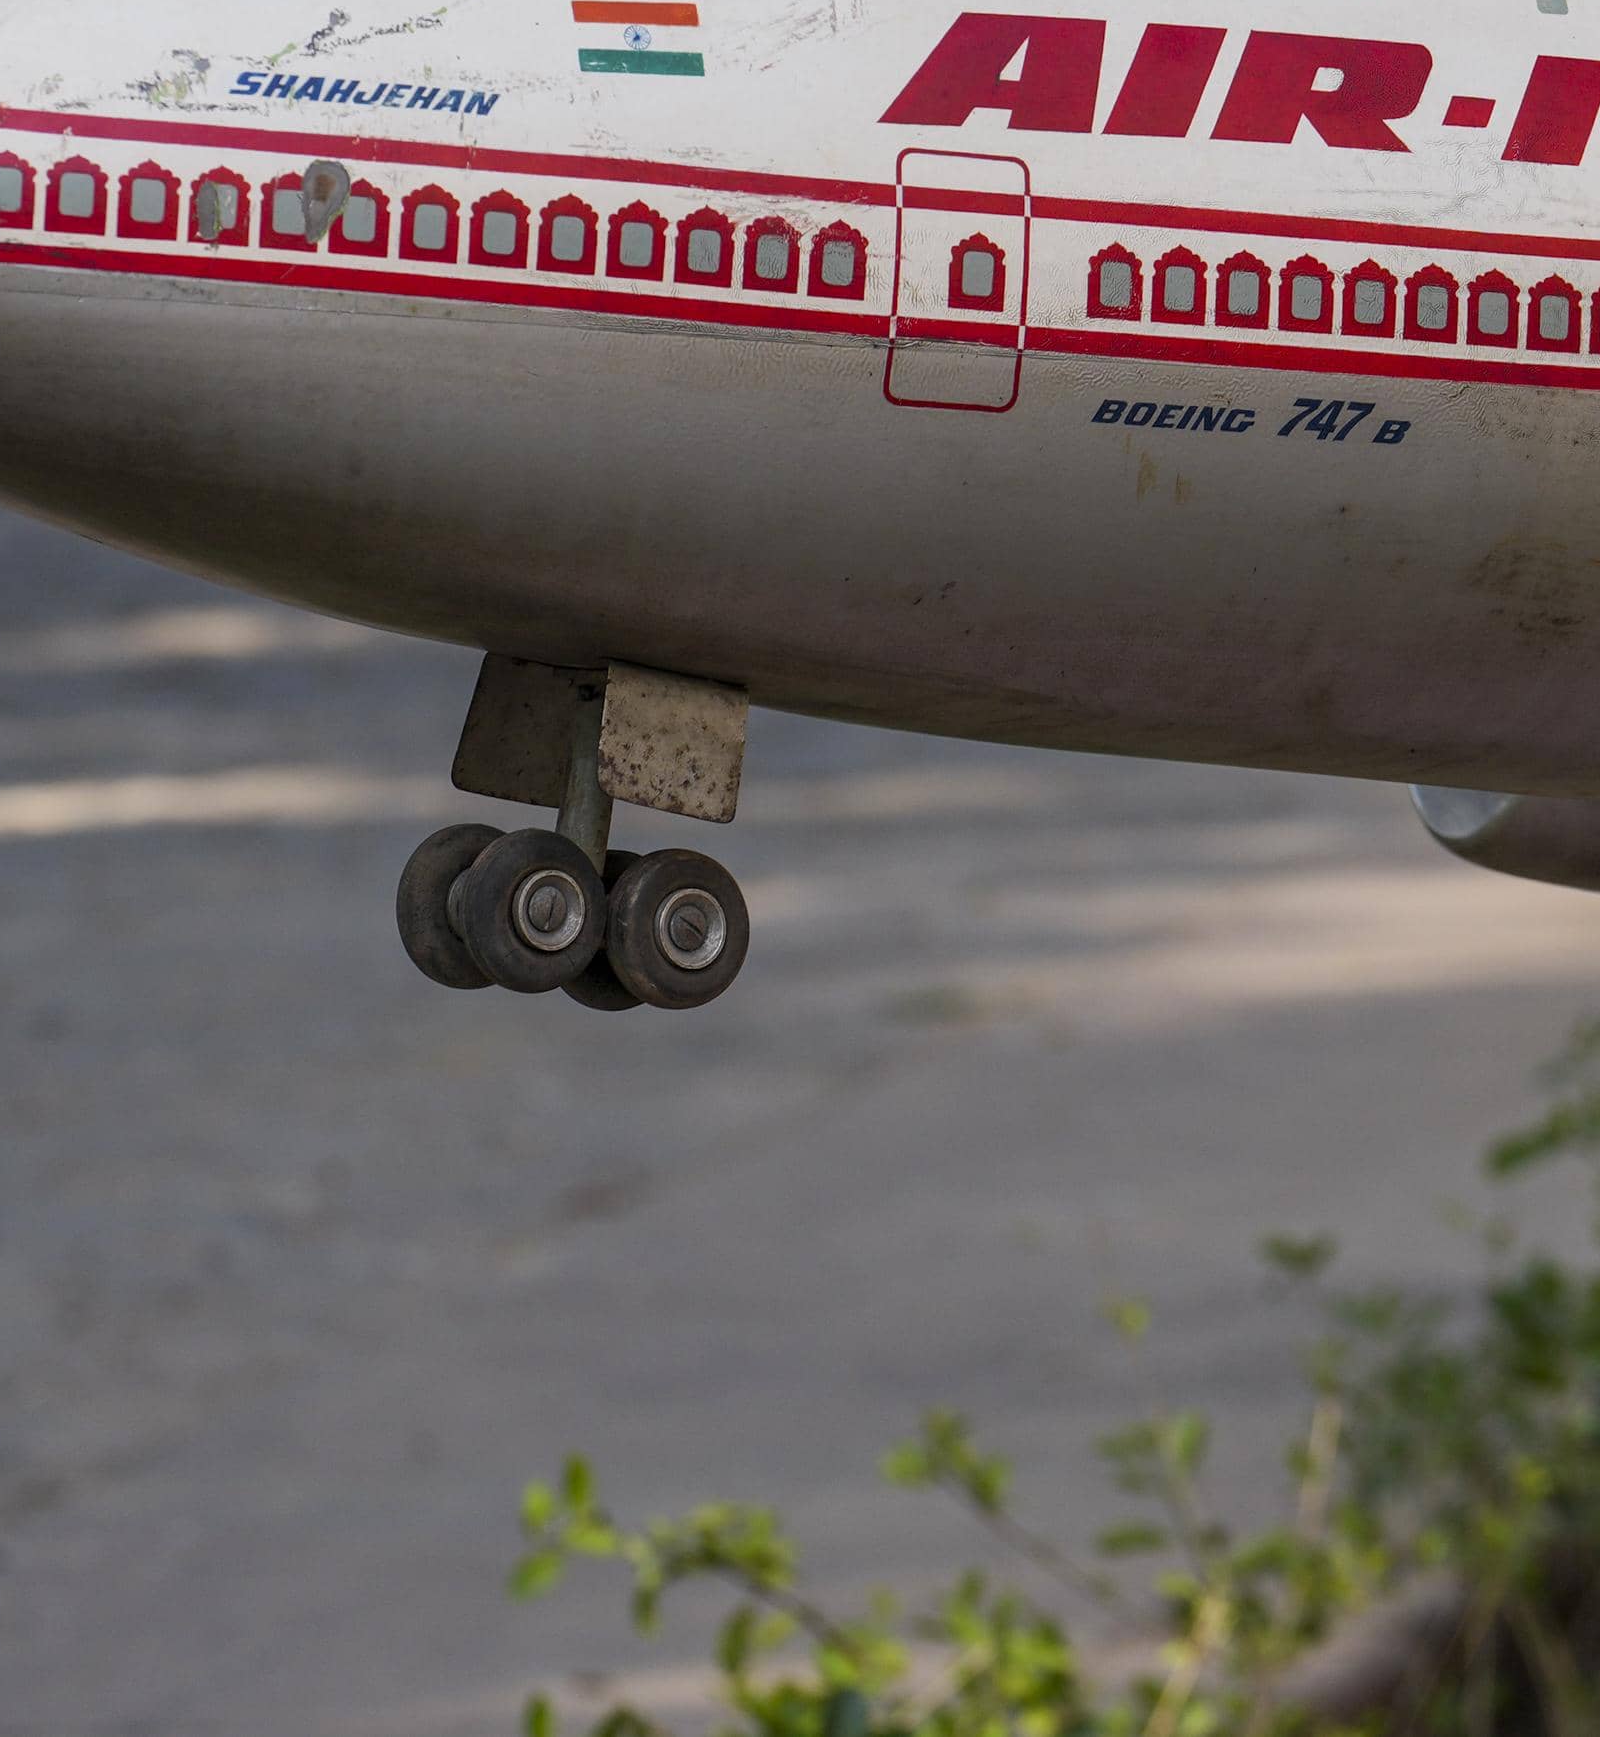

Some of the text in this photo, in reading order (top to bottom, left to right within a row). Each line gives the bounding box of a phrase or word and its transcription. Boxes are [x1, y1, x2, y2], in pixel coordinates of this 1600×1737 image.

[229, 70, 501, 117] SHAHJEHAN
[1091, 398, 1412, 445] BOEING 747 B
